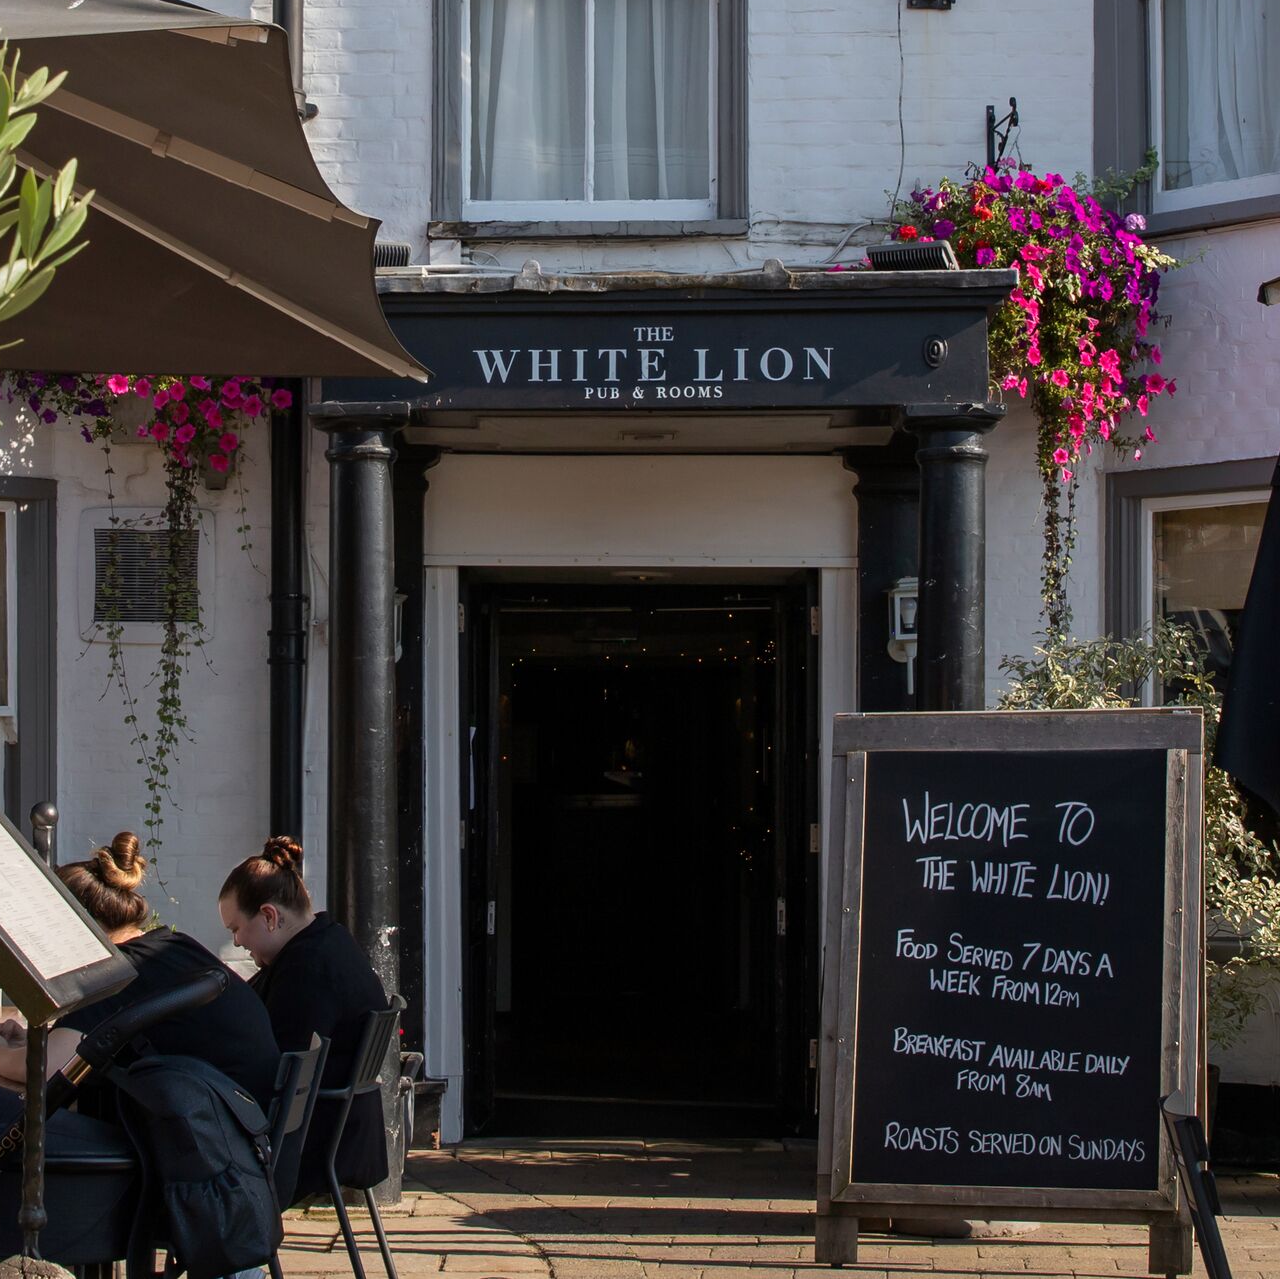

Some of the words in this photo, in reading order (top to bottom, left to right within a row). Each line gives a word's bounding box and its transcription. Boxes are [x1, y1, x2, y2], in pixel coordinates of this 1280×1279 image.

[633, 327, 674, 342] THE
[472, 348, 666, 383] WHITE
[693, 347, 834, 381] LION
[584, 387, 620, 400] PUB
[632, 385, 644, 400] &
[655, 385, 723, 400] ROOMS
[902, 791, 1030, 848] WELCOME
[1055, 801, 1095, 846] TO
[916, 856, 957, 891] THE
[970, 861, 1037, 898] WHITE
[1046, 863, 1110, 906] LION!
[896, 928, 938, 959] FOOD
[947, 932, 1013, 971] SERVED
[1021, 942, 1041, 971] 7
[1042, 948, 1092, 976] DAYS
[1095, 953, 1114, 978] A
[929, 968, 980, 996] WEEK
[991, 975, 1040, 1005] FROM
[1044, 982, 1080, 1008] 12PM
[893, 1026, 986, 1062] BREAKFAST
[988, 1044, 1082, 1072] AVAILABLE
[1084, 1053, 1130, 1075] DAILY
[956, 1069, 1006, 1096] FROM
[1015, 1074, 1052, 1101] 8AM
[884, 1121, 959, 1154] ROASTS
[968, 1130, 1036, 1155] SERVED
[1038, 1135, 1062, 1156] ON
[1068, 1134, 1146, 1162] SUNDAYS
